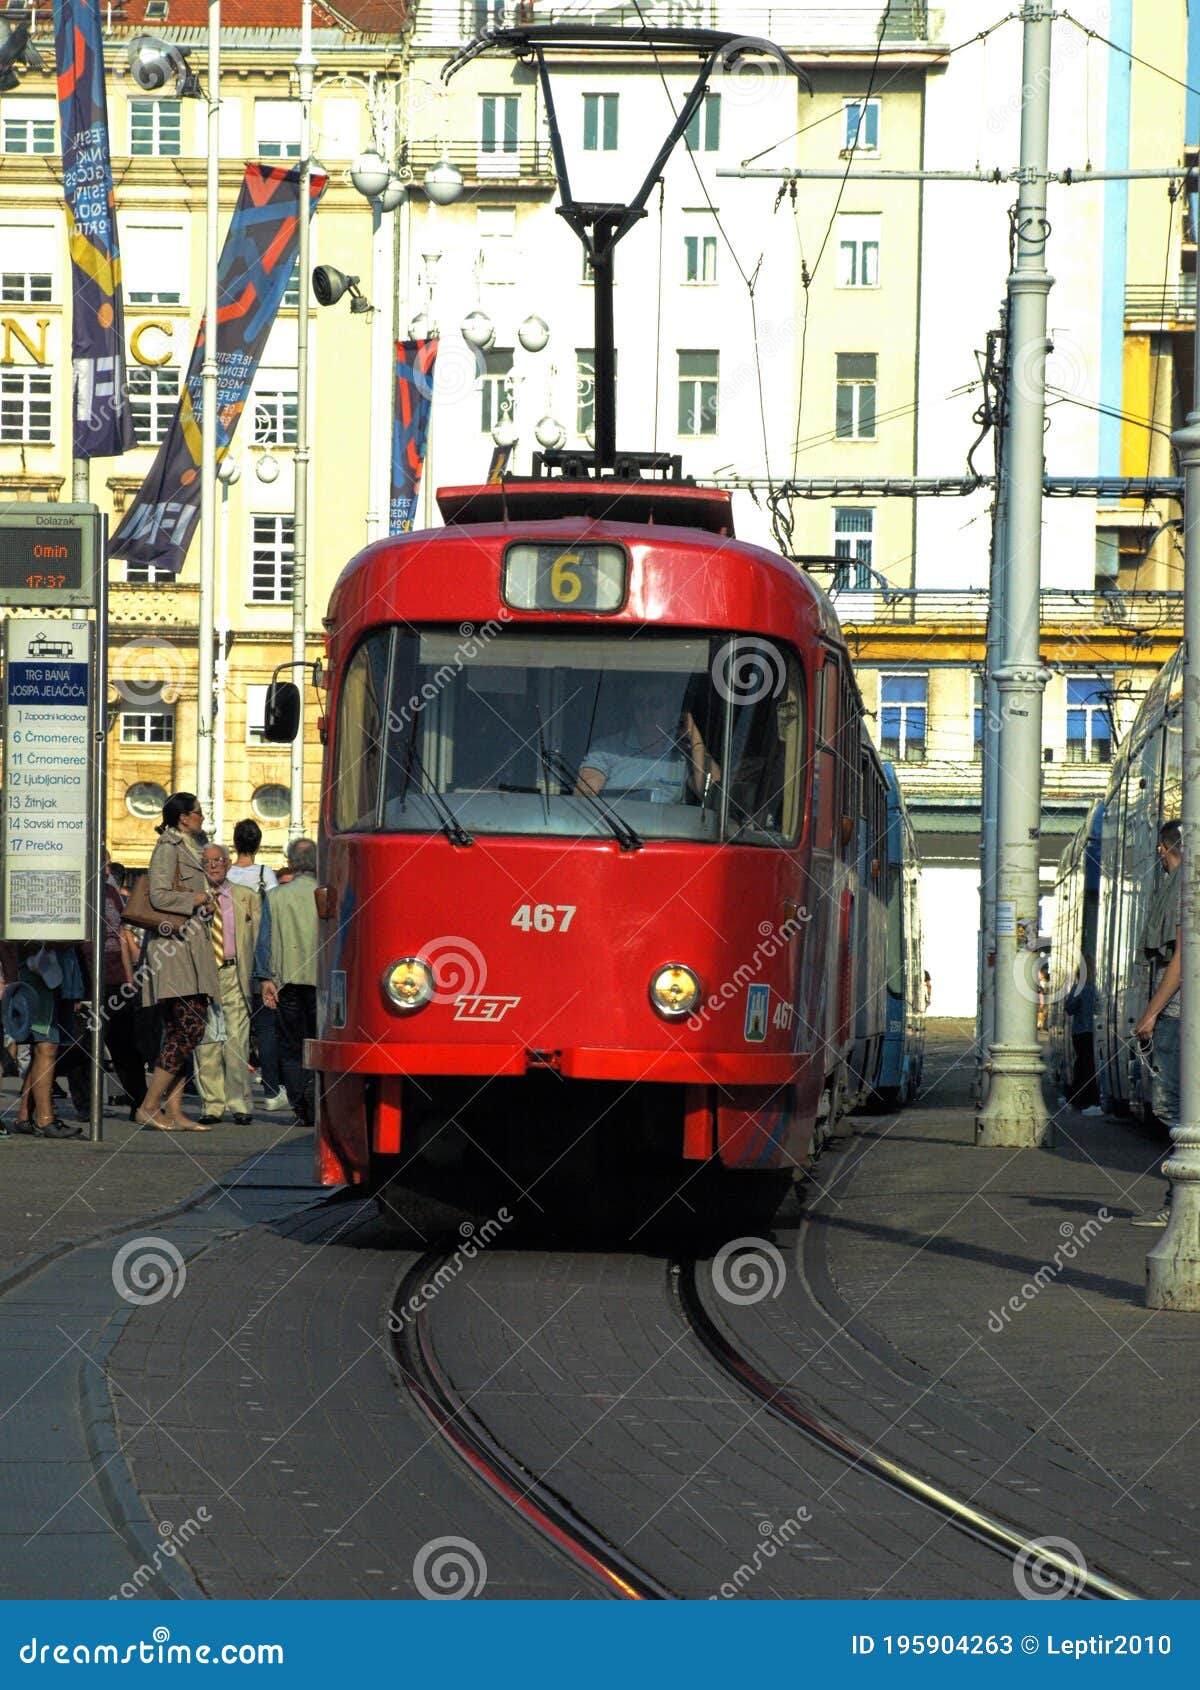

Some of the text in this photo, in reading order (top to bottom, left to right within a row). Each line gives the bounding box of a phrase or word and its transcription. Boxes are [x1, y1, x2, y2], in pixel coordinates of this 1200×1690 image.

[1, 318, 50, 367] N
[36, 516, 75, 527] Dolazak
[26, 575, 67, 588] 17:37
[551, 553, 582, 604] 6
[25, 669, 70, 681] TRG BANA
[11, 683, 85, 697] JOSIPA JELAČIĆA
[17, 711, 86, 723] 1 Zapadni kolodvor
[13, 731, 85, 744] 6 Črnomerec
[12, 753, 86, 765] 11 Črnomerec
[9, 773, 81, 787] 12 Ljubljanica
[9, 795, 57, 810] 13 Žitnjak
[9, 817, 84, 830] 14 Savski most
[11, 839, 63, 851] 17 Prečko
[511, 904, 577, 932] 467
[772, 1002, 794, 1031] 467
